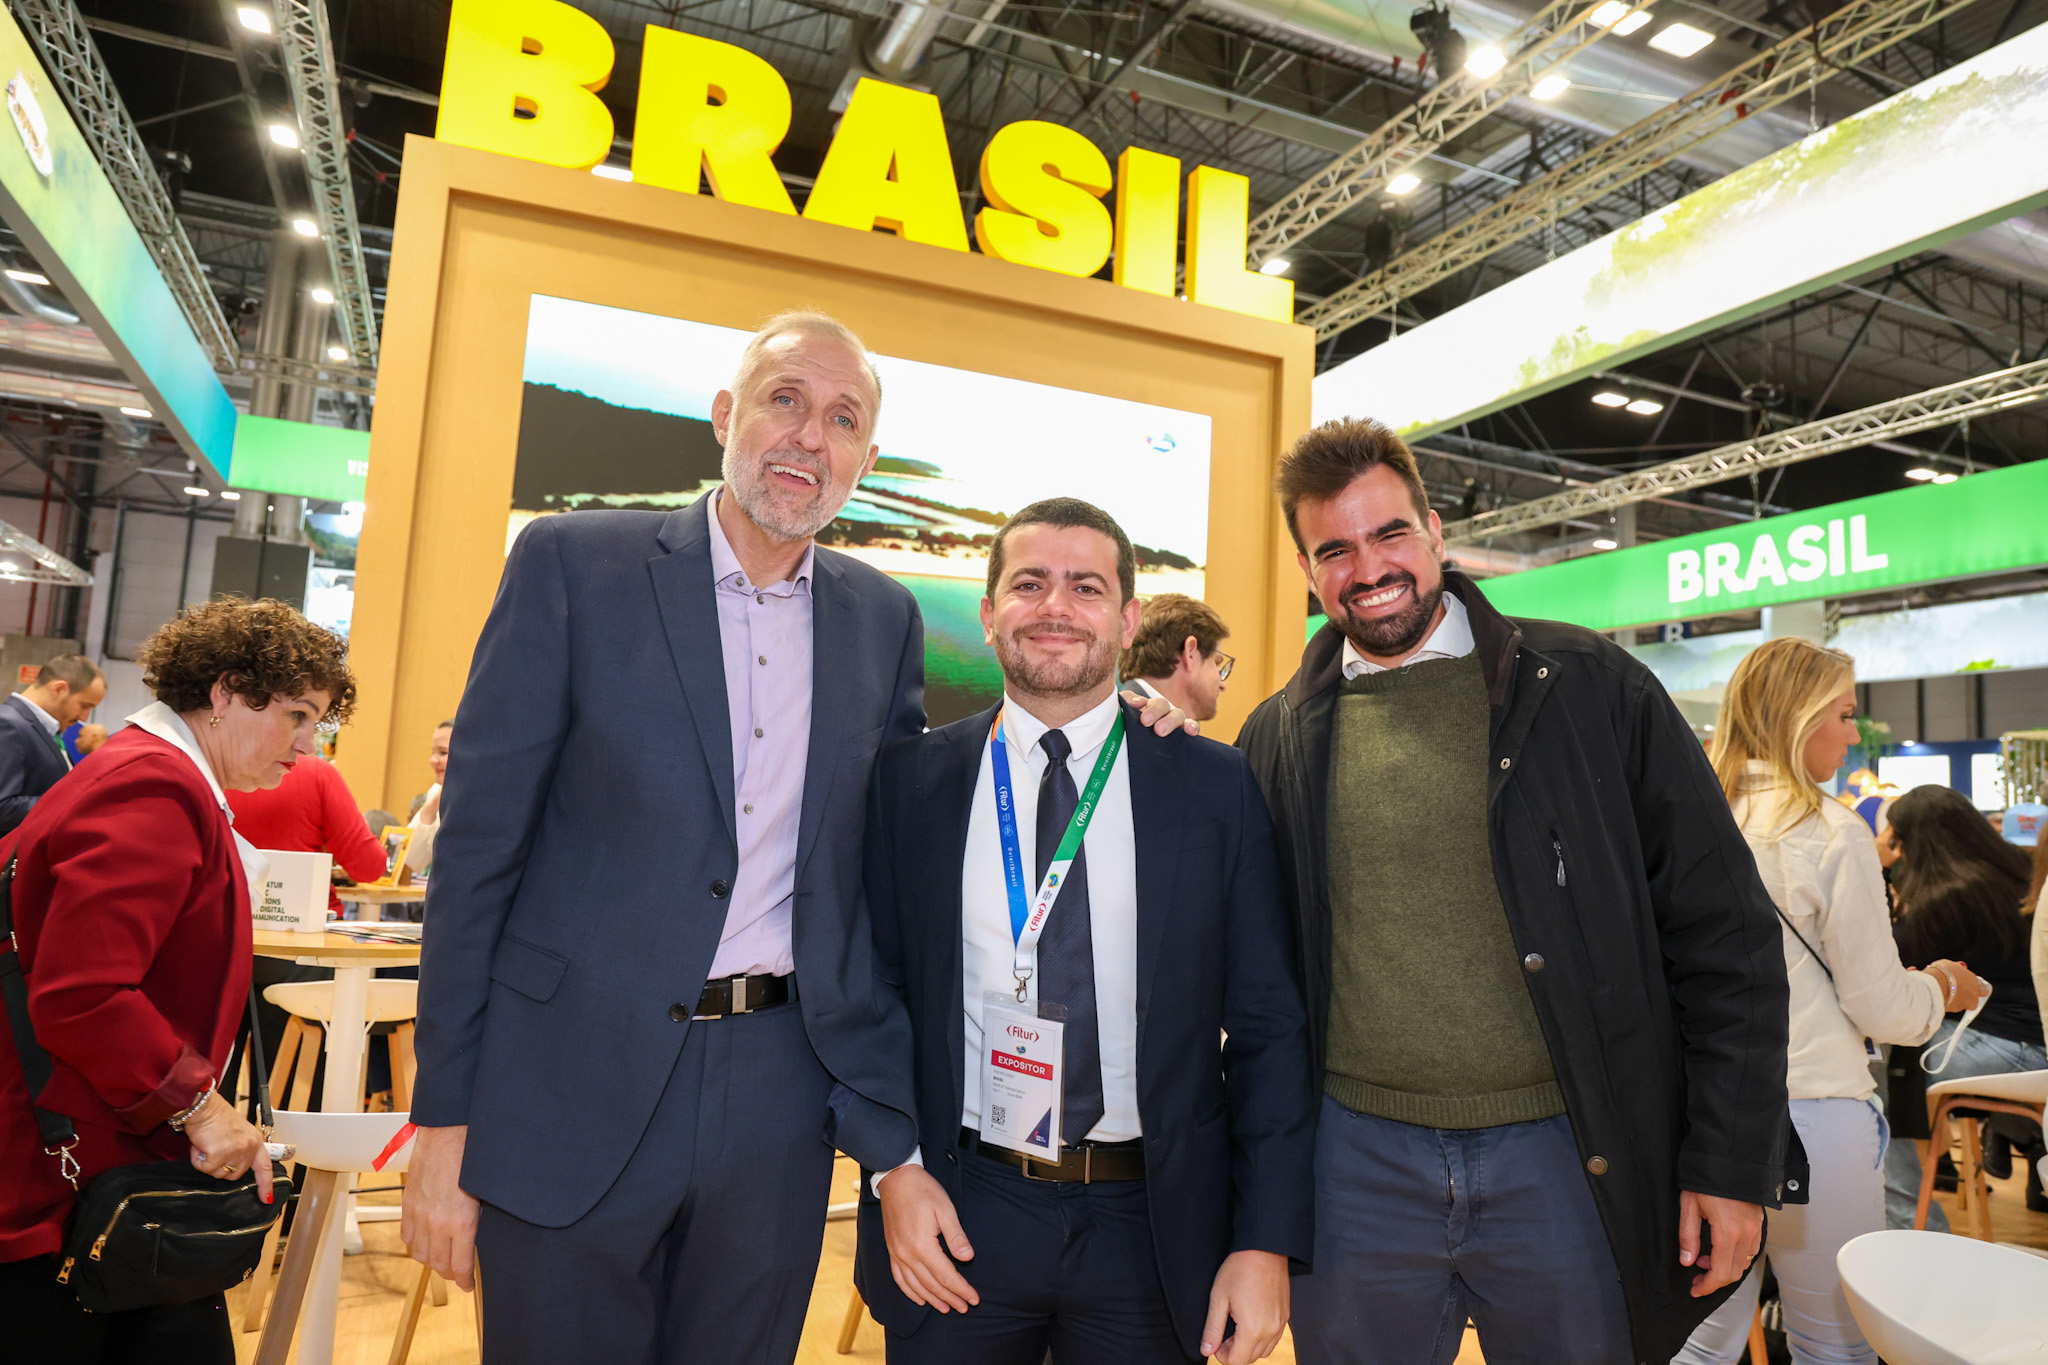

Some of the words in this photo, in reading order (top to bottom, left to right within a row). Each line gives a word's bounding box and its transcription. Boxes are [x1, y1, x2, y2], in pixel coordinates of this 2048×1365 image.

[434, 0, 1295, 324] BRASIL
[1667, 514, 1889, 603] BRASIL
[260, 905, 285, 914] DIGITAL
[998, 1055, 1046, 1076] EXPOSITOR
